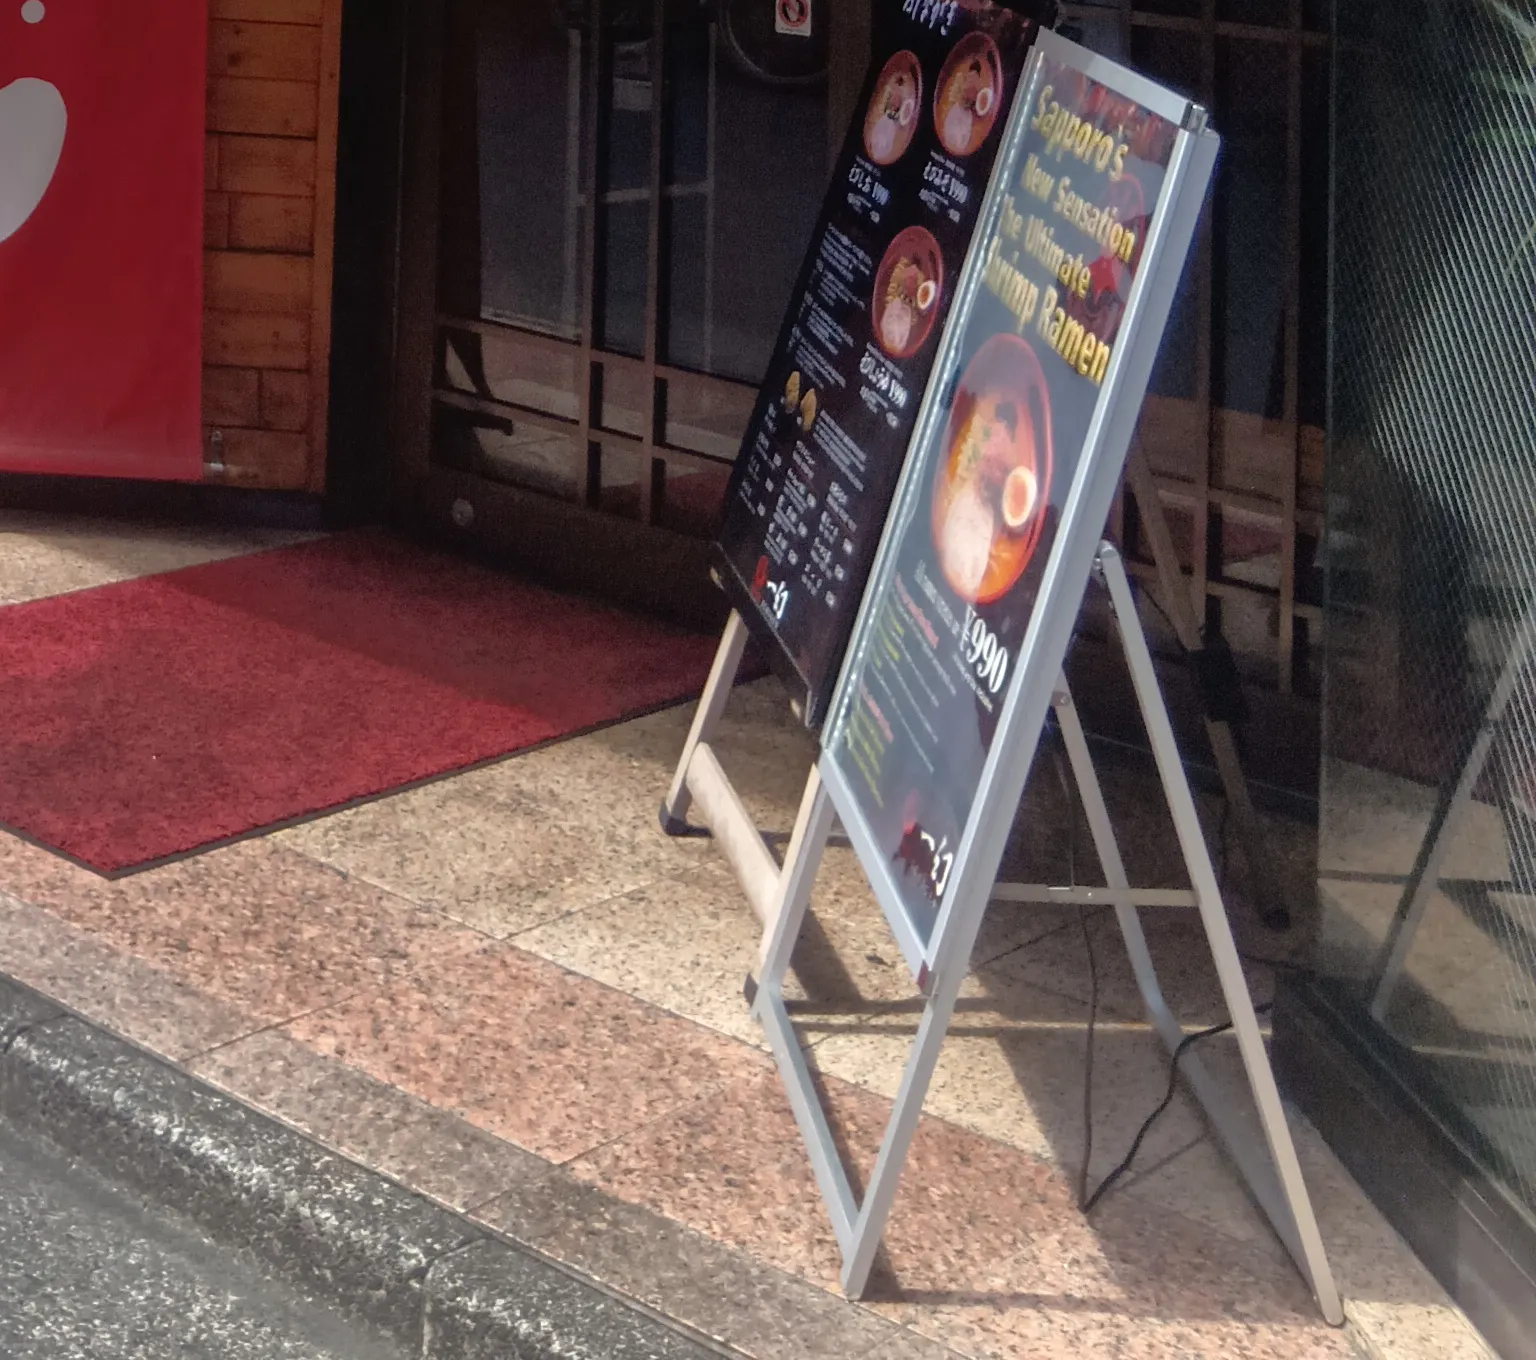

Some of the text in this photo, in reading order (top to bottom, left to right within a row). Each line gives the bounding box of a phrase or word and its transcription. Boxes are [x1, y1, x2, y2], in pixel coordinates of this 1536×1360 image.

[1032, 84, 1129, 181] Sapporo's
[1021, 152, 1136, 263] New Sensation
[1024, 214, 1092, 300] Ultimate
[1037, 284, 1111, 387] Ramen
[960, 601, 1009, 695] ¥990
